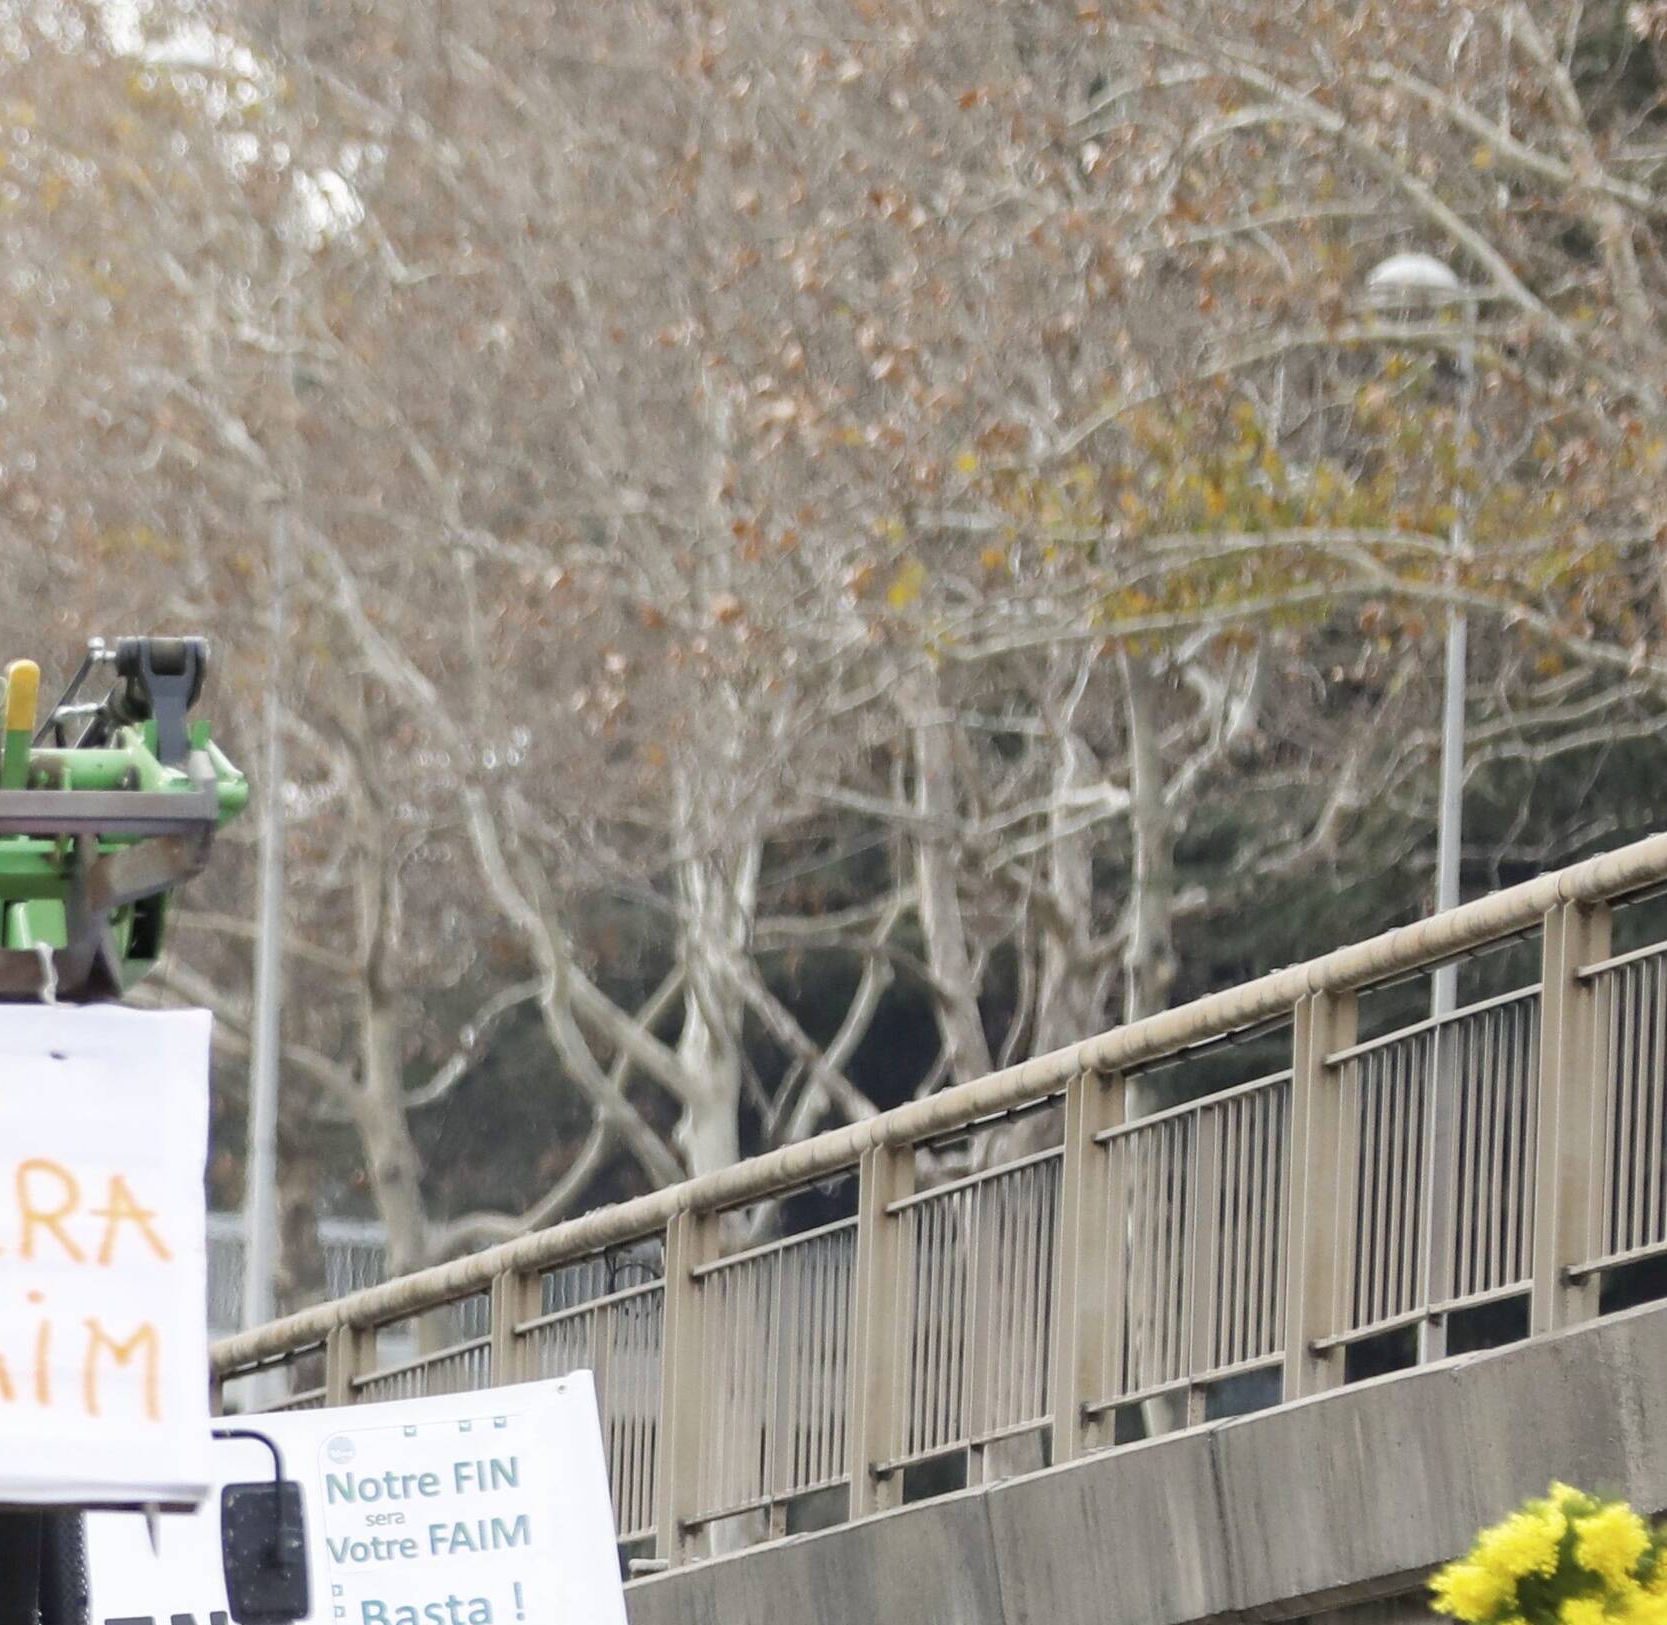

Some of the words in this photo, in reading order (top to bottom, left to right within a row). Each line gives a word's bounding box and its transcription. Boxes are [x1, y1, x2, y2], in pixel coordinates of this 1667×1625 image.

[325, 1471, 441, 1505] Notre
[453, 1455, 520, 1495] FIN
[326, 1536, 419, 1564] Votre
[428, 1513, 532, 1556] FAIM
[364, 1511, 406, 1527] sera
[513, 1581, 526, 1622] !
